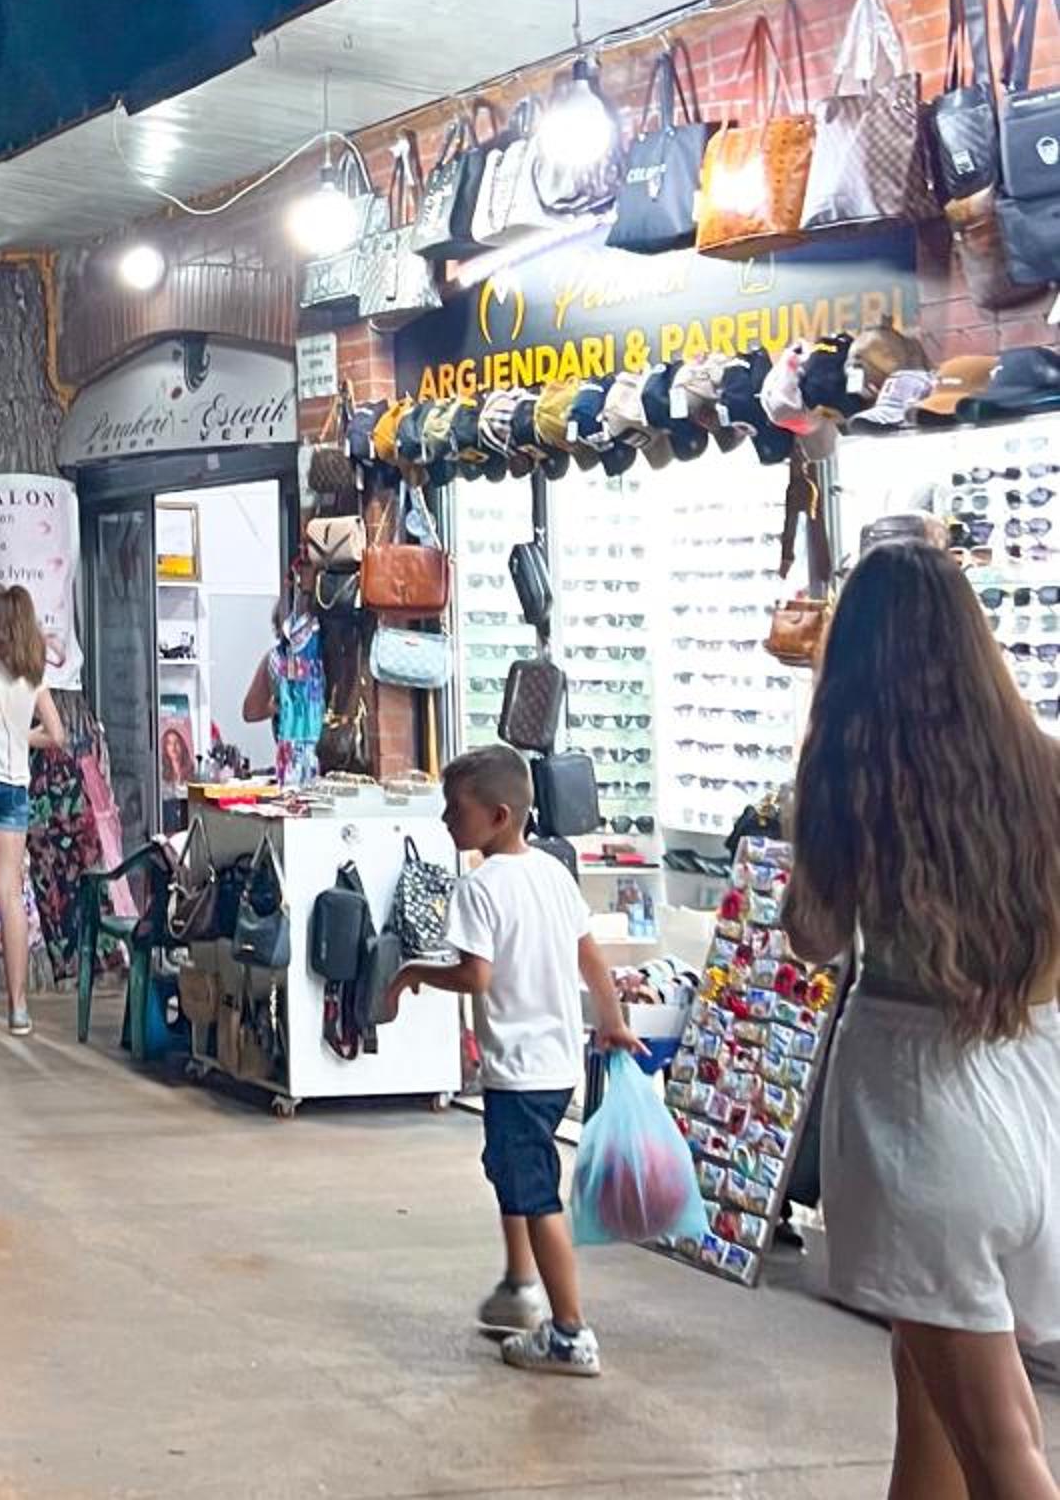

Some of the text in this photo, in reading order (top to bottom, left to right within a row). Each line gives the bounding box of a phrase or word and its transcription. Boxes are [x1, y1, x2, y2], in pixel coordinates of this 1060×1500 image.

[418, 334, 616, 402] ARGJENDARI
[623, 328, 651, 373] &
[661, 287, 904, 364] PARFUMERI
